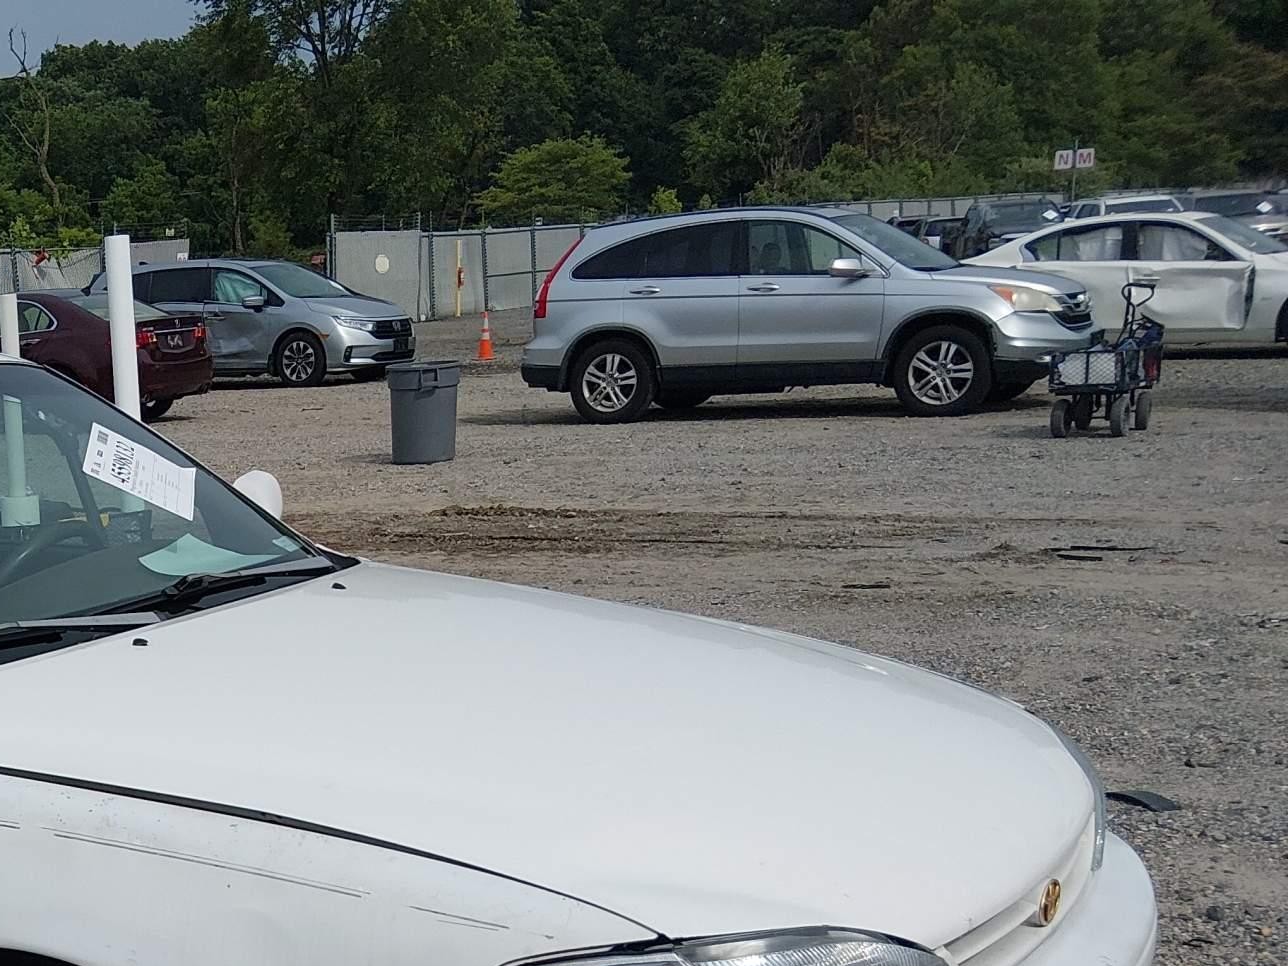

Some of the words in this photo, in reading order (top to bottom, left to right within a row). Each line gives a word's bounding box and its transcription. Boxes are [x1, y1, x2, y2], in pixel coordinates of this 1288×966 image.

[1057, 151, 1069, 166] N
[1078, 151, 1092, 165] M
[110, 440, 136, 485] 45598132
